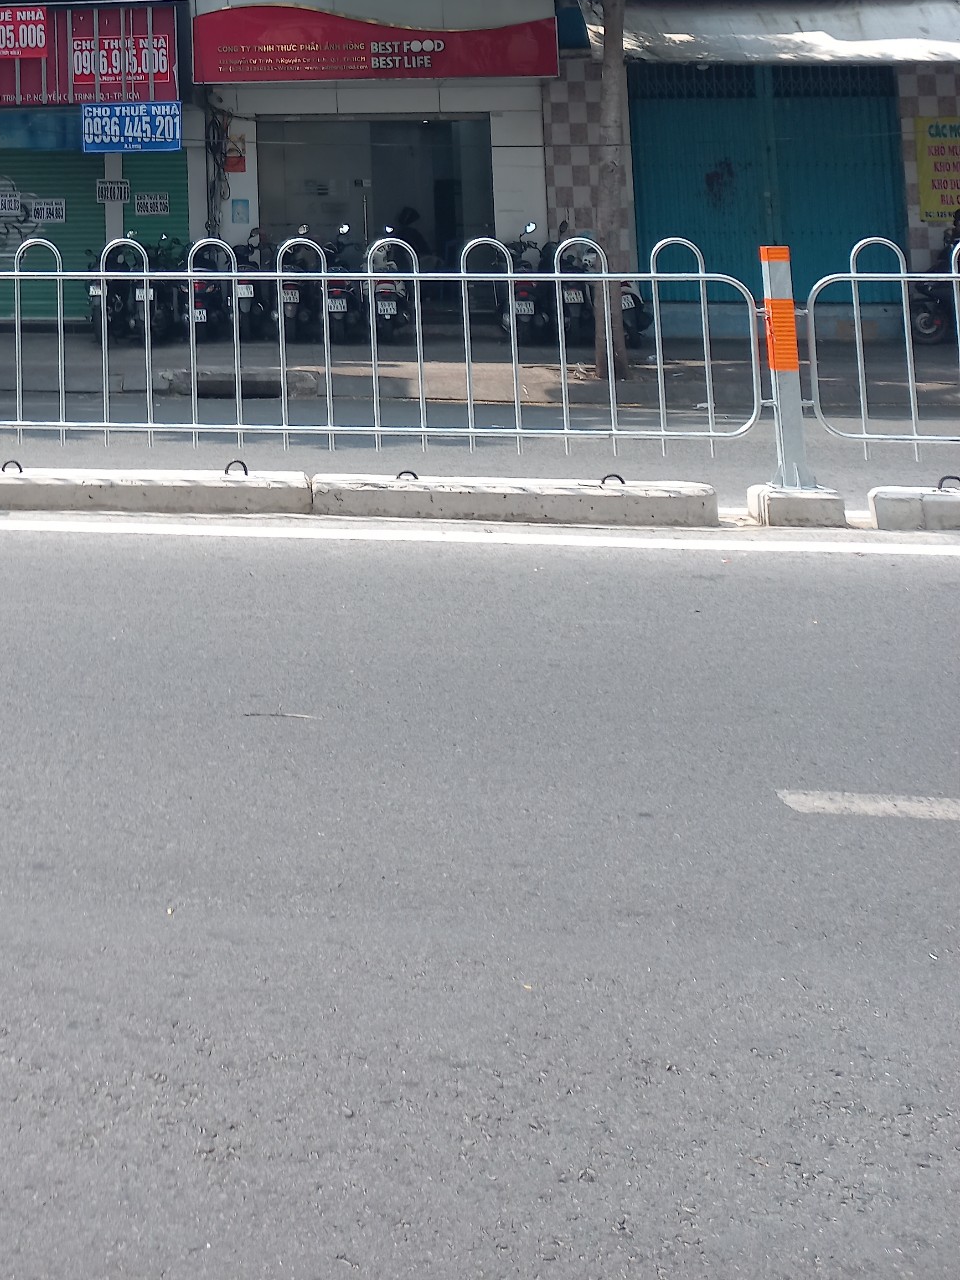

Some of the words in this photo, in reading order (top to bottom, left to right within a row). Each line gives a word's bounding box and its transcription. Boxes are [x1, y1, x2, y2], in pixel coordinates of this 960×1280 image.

[16, 8, 45, 21] NHÀ
[370, 41, 399, 54] BEST
[403, 39, 445, 53] FOOD
[371, 56, 401, 69] BEST
[404, 55, 432, 68] LIFE
[84, 106, 111, 117] CHO
[114, 103, 148, 116] THUÊ
[151, 103, 180, 116] NHÀ
[84, 115, 180, 144] 0936.445.201
